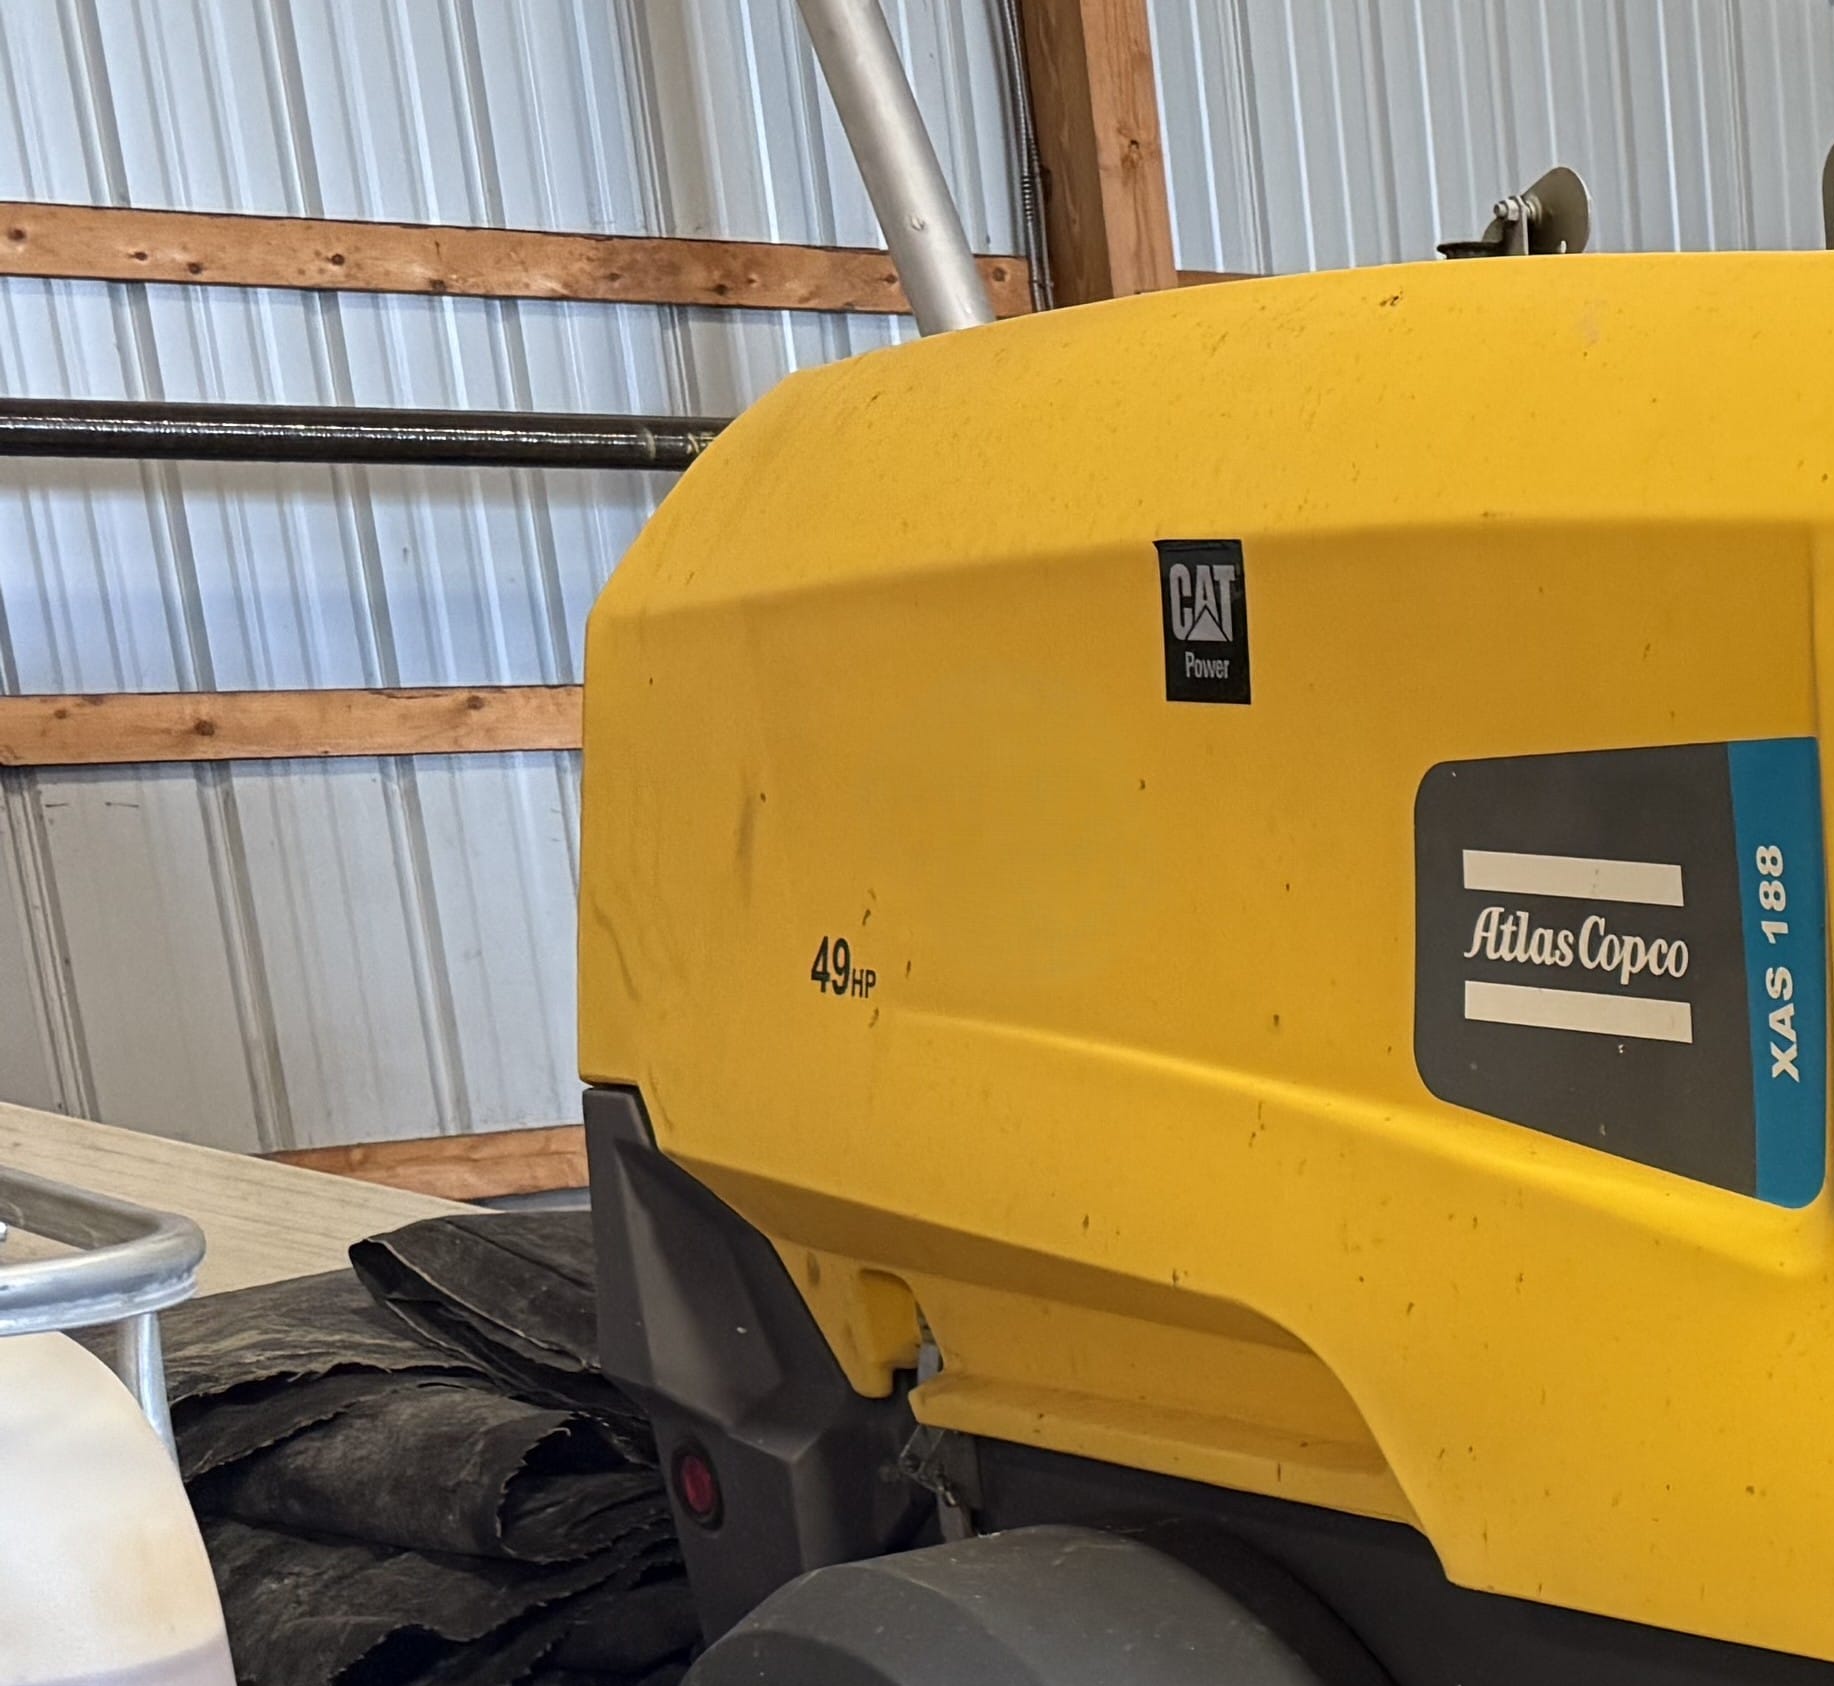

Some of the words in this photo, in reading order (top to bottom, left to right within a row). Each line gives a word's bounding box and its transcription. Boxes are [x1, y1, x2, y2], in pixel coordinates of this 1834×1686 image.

[1169, 563, 1236, 642] CAT
[1184, 651, 1230, 680] Power
[1756, 845, 1789, 944] 188
[1463, 906, 1575, 967] Atlas
[1578, 915, 1689, 985] Copco
[1765, 966, 1800, 1083] XAS
